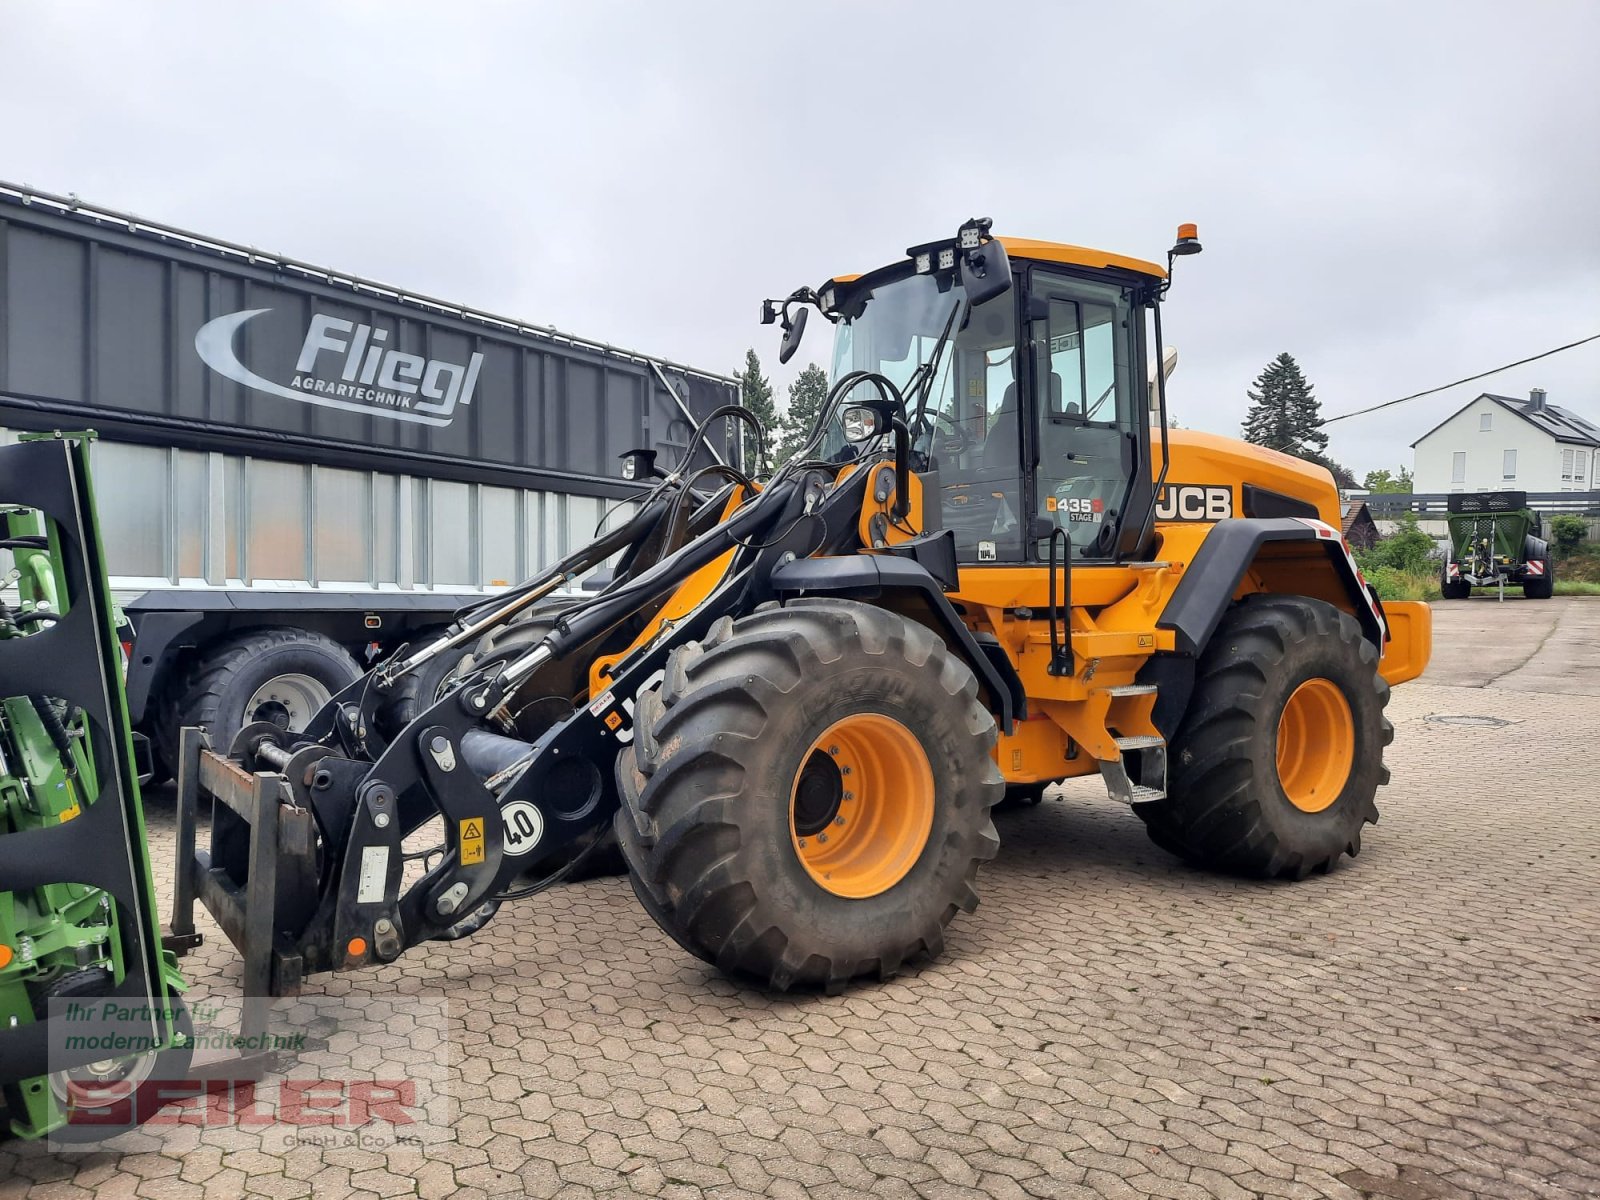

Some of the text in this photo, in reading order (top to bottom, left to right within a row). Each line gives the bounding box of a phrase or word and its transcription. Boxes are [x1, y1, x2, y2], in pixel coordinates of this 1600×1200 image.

[295, 313, 484, 416] Fliegl
[291, 375, 412, 408] AGRARTECHNIK
[1070, 513, 1093, 521] STAGE
[1155, 486, 1231, 519] JCB
[502, 810, 534, 845] 40
